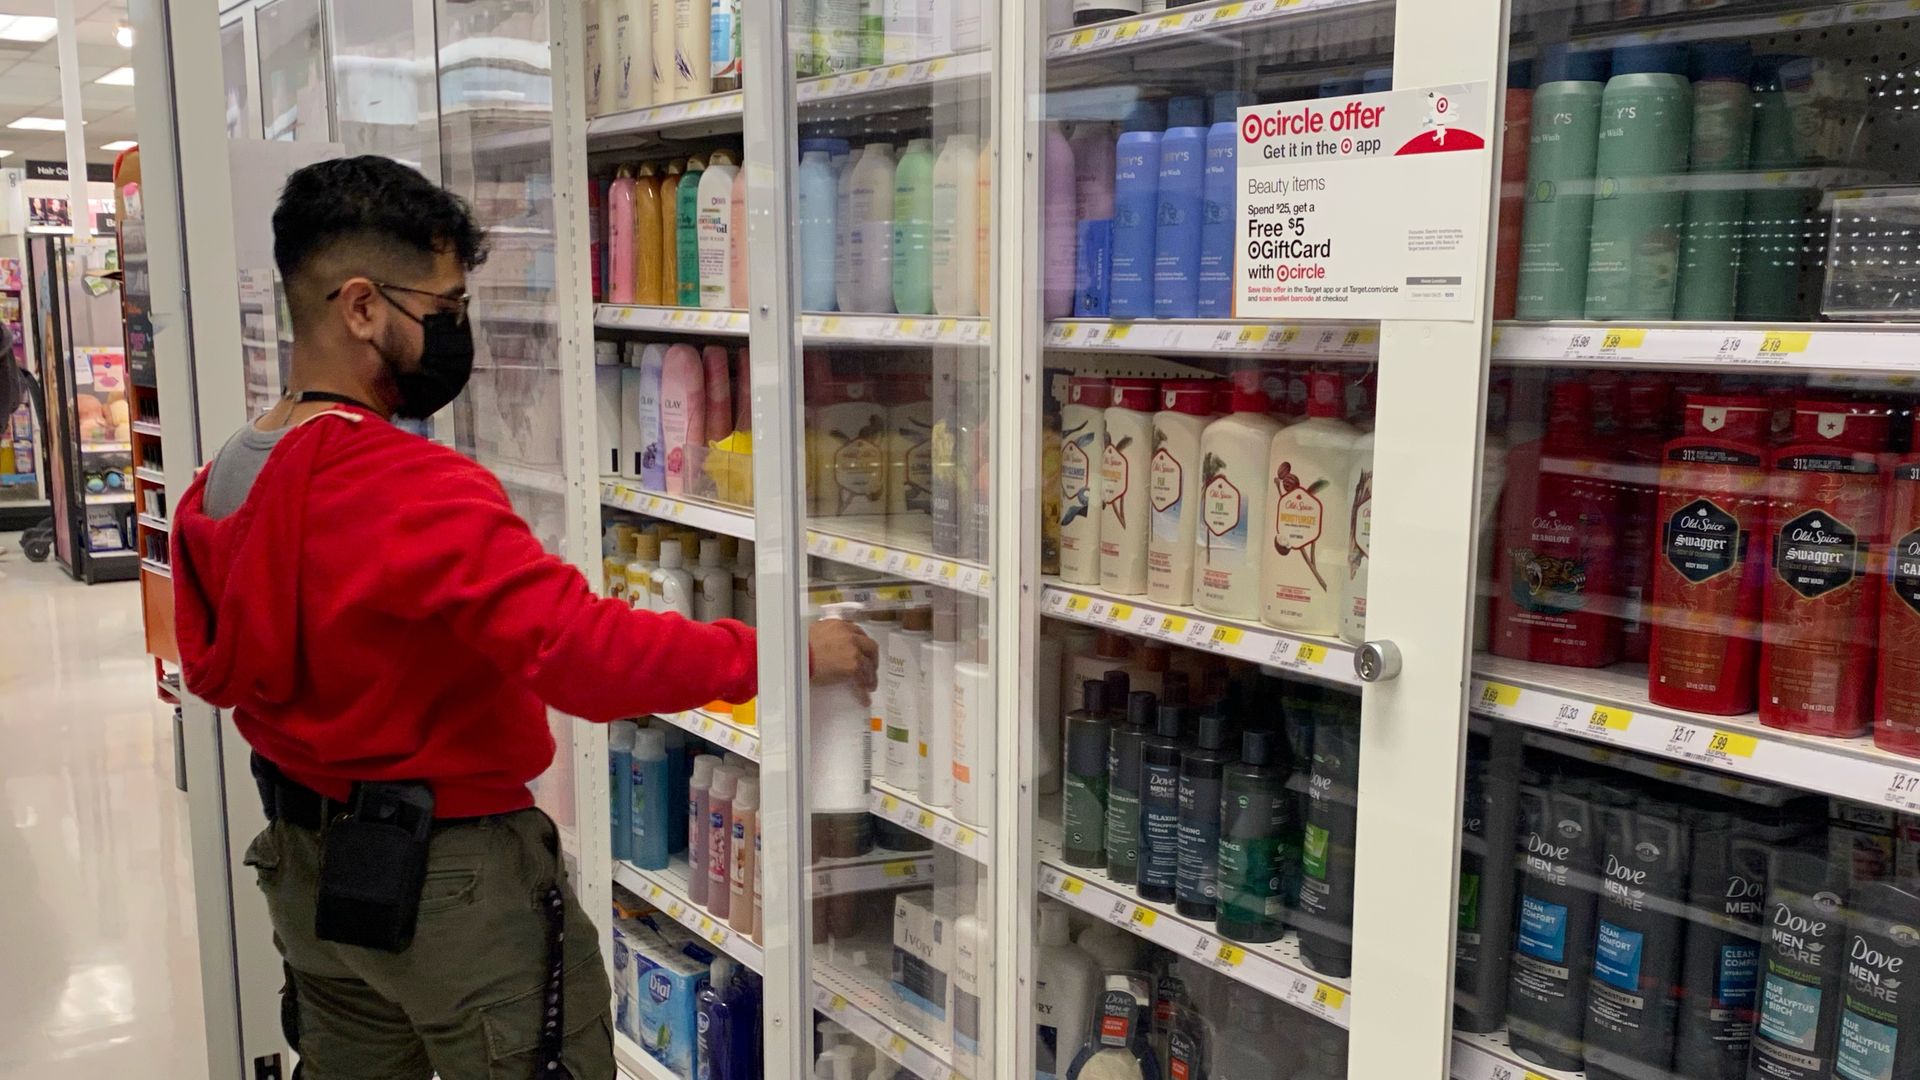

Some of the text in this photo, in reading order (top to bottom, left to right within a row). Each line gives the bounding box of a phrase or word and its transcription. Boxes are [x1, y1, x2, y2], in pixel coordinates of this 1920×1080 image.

[1263, 101, 1385, 137] circle offer
[1541, 133, 1560, 143] Wash
[1606, 129, 1624, 138] Wash
[1263, 138, 1381, 159] Get it in the app
[37, 166, 69, 176] Hair Co
[1248, 176, 1326, 197] Beauty items
[1247, 203, 1315, 216] Spend $25, get a
[1248, 218, 1305, 238] Free $5
[1261, 239, 1331, 258] GiftCard
[1247, 264, 1325, 280] with circle
[1304, 286, 1322, 294] Target
[1349, 286, 1399, 294] Target.com/circle
[1570, 335, 1591, 348] 15.98
[1602, 335, 1621, 348] 7.99
[1720, 338, 1742, 351] 2.19
[1760, 338, 1781, 352] 2.19
[664, 400, 681, 409] OLAY
[1910, 467, 1920, 480] 31
[1285, 500, 1313, 511] Old Spice
[1532, 516, 1574, 532] Old Spice
[1680, 515, 1724, 532] Old Spice
[1531, 533, 1571, 545] BEARGLOVE
[1674, 534, 1727, 551] Swagger
[1791, 528, 1841, 545] Old Spice
[1785, 547, 1844, 565] Swagger
[1559, 705, 1579, 720] 10.33
[1672, 726, 1696, 743] 12.17
[1709, 735, 1728, 750] 7.99
[1150, 773, 1176, 786] Dove
[1891, 774, 1920, 792] 12.17
[1150, 785, 1167, 793] MEN
[1148, 813, 1177, 821] RELAXIN
[1462, 817, 1481, 832] ve
[1178, 823, 1201, 835] LAXING
[1528, 831, 1569, 860] Dove
[1526, 855, 1552, 872] MEN
[1605, 854, 1647, 885] Dove
[1527, 867, 1567, 886] CARE
[1604, 878, 1628, 897] MEN
[1725, 875, 1763, 898] Dov
[1523, 900, 1544, 912] CLEAN
[1605, 889, 1643, 912] CARE
[1725, 901, 1762, 914] MEN
[1523, 908, 1556, 924] COMFORT
[1773, 902, 1827, 938] Dove
[1600, 925, 1620, 939] CLEAN
[1771, 928, 1804, 950] MEN
[1600, 934, 1631, 952] COMFORT
[1725, 950, 1756, 958] CLEAN
[1851, 935, 1904, 973] Dove
[1724, 958, 1758, 967] COMFO
[1849, 962, 1880, 986] MEN
[650, 974, 671, 998] Dial
[1766, 981, 1784, 995] BLUE
[1105, 992, 1132, 1005] Dove
[1765, 991, 1815, 1014] EUCALYPTUS
[1038, 1003, 1053, 1015] RY
[1768, 1002, 1793, 1017] BIRCH
[1843, 1017, 1859, 1032] BLUE
[1842, 1027, 1891, 1053] EUCALYPTUS
[1845, 1038, 1868, 1056] BIRCH
